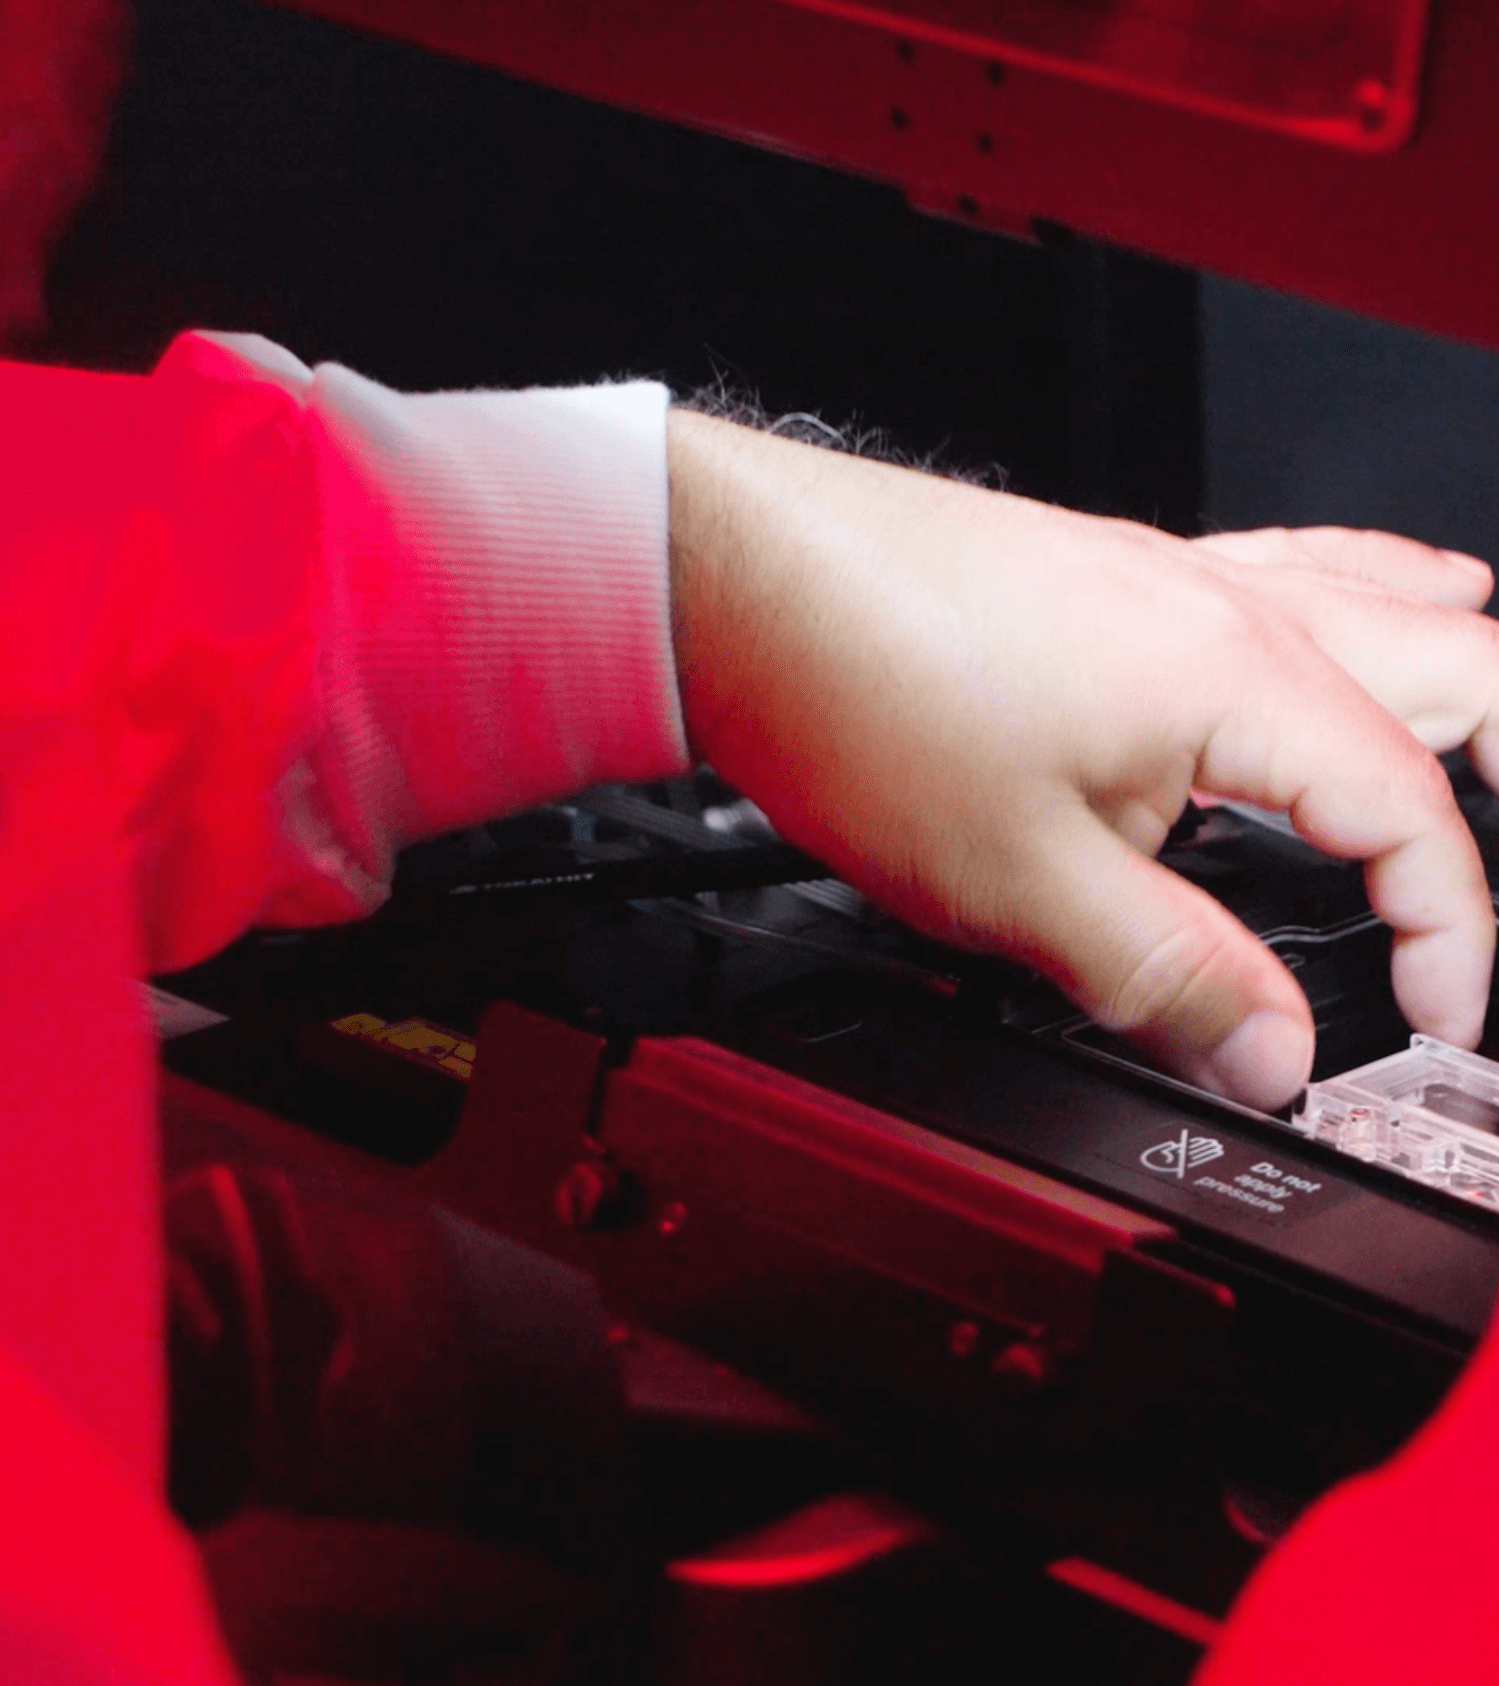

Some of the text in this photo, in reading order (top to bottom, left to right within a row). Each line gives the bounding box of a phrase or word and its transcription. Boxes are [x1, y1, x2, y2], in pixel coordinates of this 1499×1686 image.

[1234, 1174, 1292, 1198] apply
[1250, 1162, 1322, 1193] Do not
[1193, 1176, 1285, 1213] pressure
